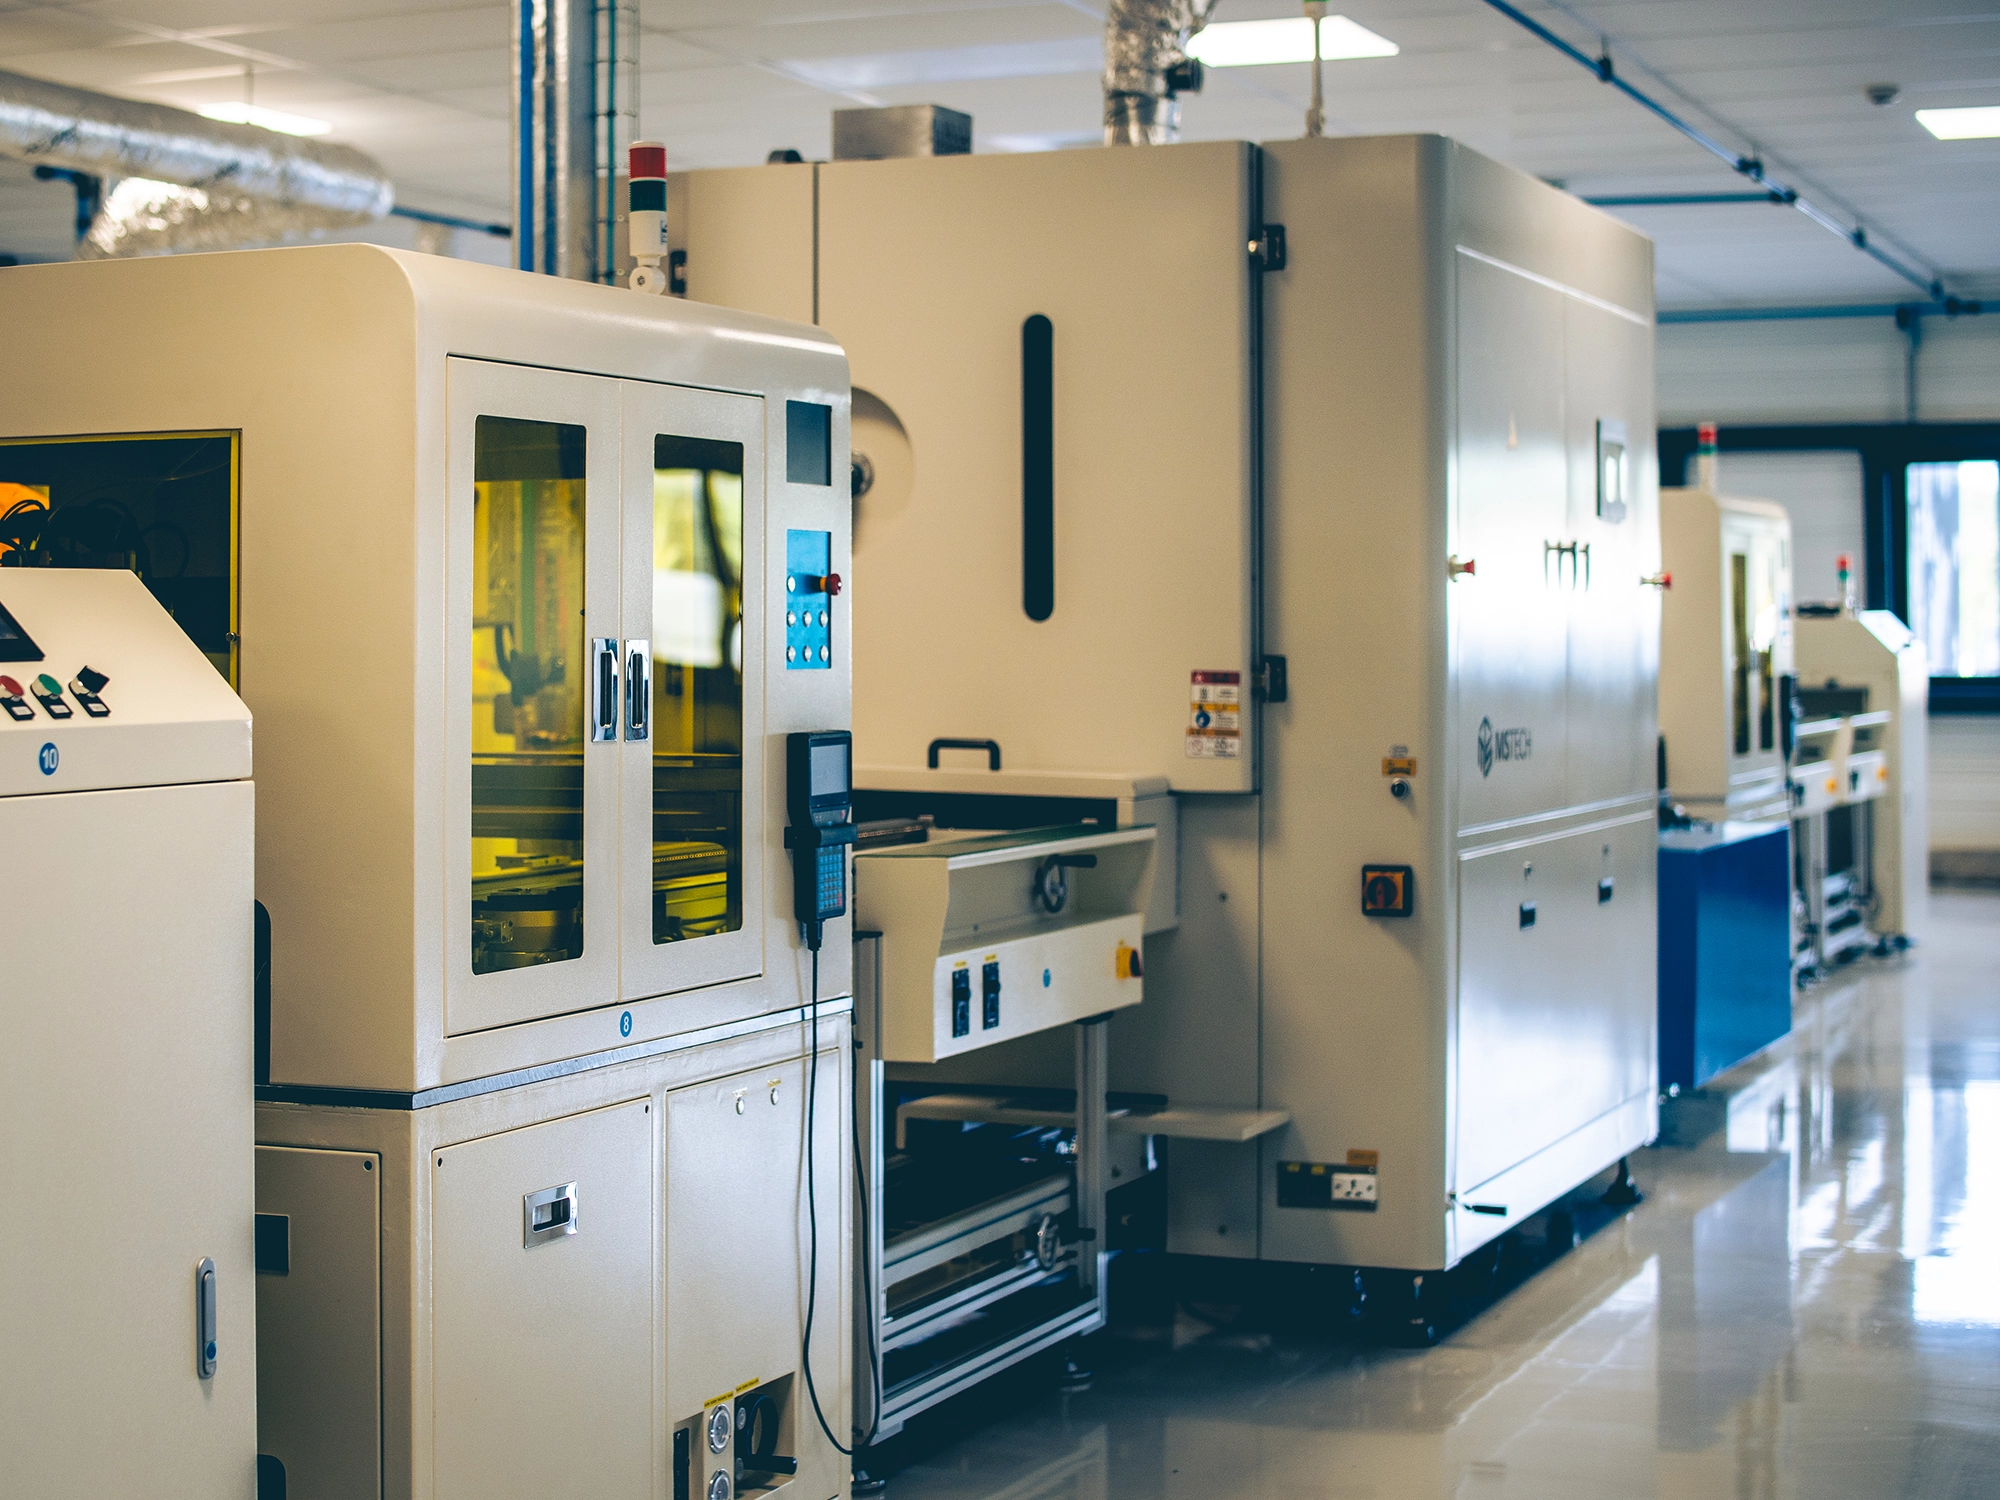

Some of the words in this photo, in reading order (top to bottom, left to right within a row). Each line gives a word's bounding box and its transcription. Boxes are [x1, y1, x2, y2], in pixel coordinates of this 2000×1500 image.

[1495, 728, 1532, 761] MSTECH
[42, 748, 58, 769] 10
[623, 1016, 630, 1032] 8
